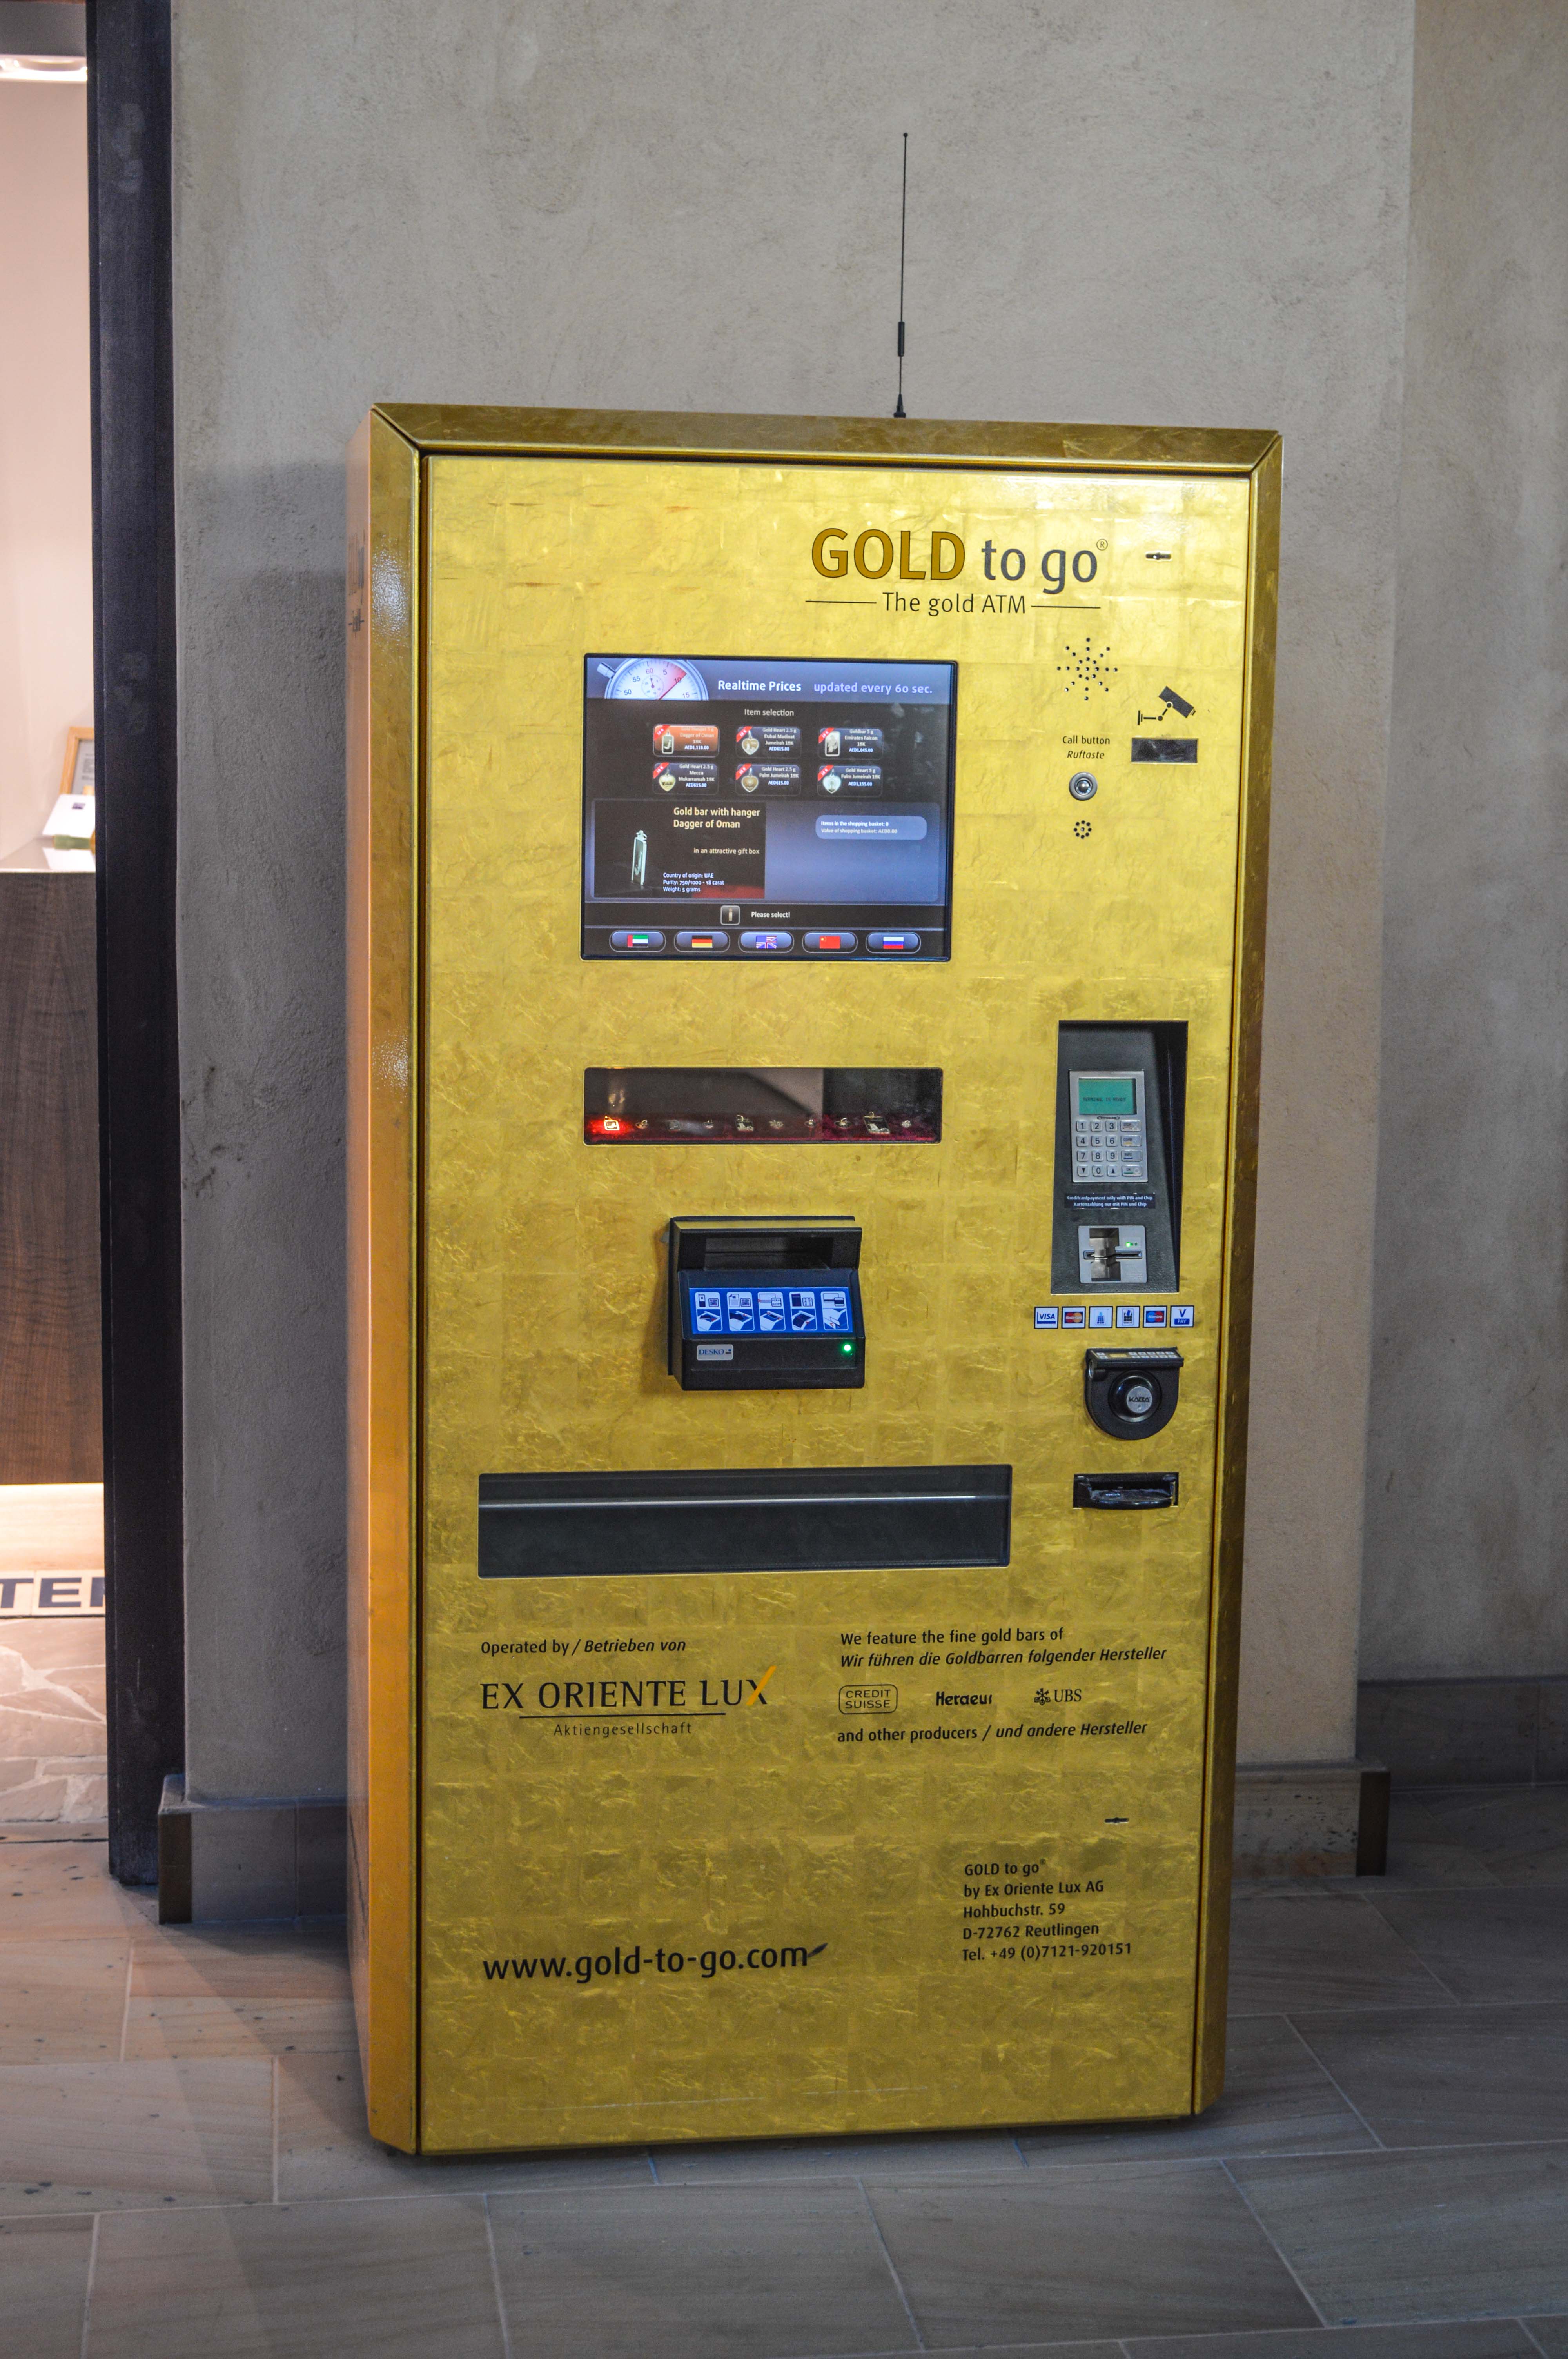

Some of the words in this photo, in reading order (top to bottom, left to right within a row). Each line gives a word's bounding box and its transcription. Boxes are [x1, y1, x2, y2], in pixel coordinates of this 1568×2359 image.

[812, 528, 965, 580] GOLD
[981, 540, 1026, 581] to
[883, 592, 920, 611] The
[928, 594, 974, 616] gold
[981, 596, 1025, 614] ATM
[718, 680, 766, 691] Realtime
[769, 681, 801, 692] Prices
[814, 682, 858, 694] updated
[862, 684, 892, 695] every
[895, 685, 909, 694] 60
[912, 685, 932, 694] sec.
[744, 708, 760, 716] Item
[1063, 735, 1078, 744] Call
[1082, 735, 1110, 745] button
[1067, 750, 1105, 759] Ruftaste
[731, 808, 760, 818] hanger
[673, 820, 703, 829] Dagger
[706, 820, 714, 828] of
[716, 820, 740, 828] Oman
[841, 1633, 861, 1645] We
[867, 1631, 916, 1645] feature
[922, 1631, 943, 1644] the
[949, 1630, 976, 1643] fine
[981, 1629, 1011, 1645] gold
[1016, 1629, 1044, 1641] bars
[1050, 1627, 1063, 1640] of
[481, 1640, 546, 1657] Operated
[552, 1639, 569, 1656] by
[584, 1639, 654, 1652] Betrieben
[660, 1641, 686, 1652] von
[841, 1654, 864, 1668] Wir
[868, 1653, 914, 1667] führen
[919, 1652, 940, 1665] die
[946, 1652, 1023, 1665] Goldbarren
[1028, 1650, 1095, 1667] folgender
[1099, 1648, 1167, 1661] Hersteller
[480, 1683, 524, 1709] EX
[539, 1681, 686, 1708] ORIENTE
[699, 1665, 777, 1706] LUX
[846, 1689, 891, 1698] CREDIT
[1054, 1689, 1082, 1702] UBS
[846, 1699, 891, 1709] SUISSE
[554, 1723, 691, 1738] Aktiengesellschaft
[837, 1729, 863, 1742] and
[869, 1728, 904, 1741] other
[910, 1727, 977, 1743] producers
[996, 1725, 1022, 1738] und
[1027, 1724, 1075, 1737] andere
[1080, 1721, 1148, 1735] Hersteller
[965, 1863, 1000, 1876] GOLD
[1005, 1863, 1018, 1874] to
[964, 1885, 980, 1899] by
[985, 1885, 999, 1896] Ex
[1004, 1883, 1053, 1895] Oriente
[1059, 1881, 1081, 1893] Lux
[1085, 1881, 1103, 1892] AG
[964, 1904, 1043, 1918] Hohbuchstr.
[1049, 1903, 1065, 1915] 59
[963, 1926, 1020, 1939] D-72762
[1025, 1923, 1099, 1938] Reutlingen
[963, 1947, 985, 1961] Tel.
[991, 1947, 1015, 1959] +49
[1021, 1943, 1131, 1961] (0)7121-920151
[483, 1946, 808, 1983] www.gold-to-go.com
